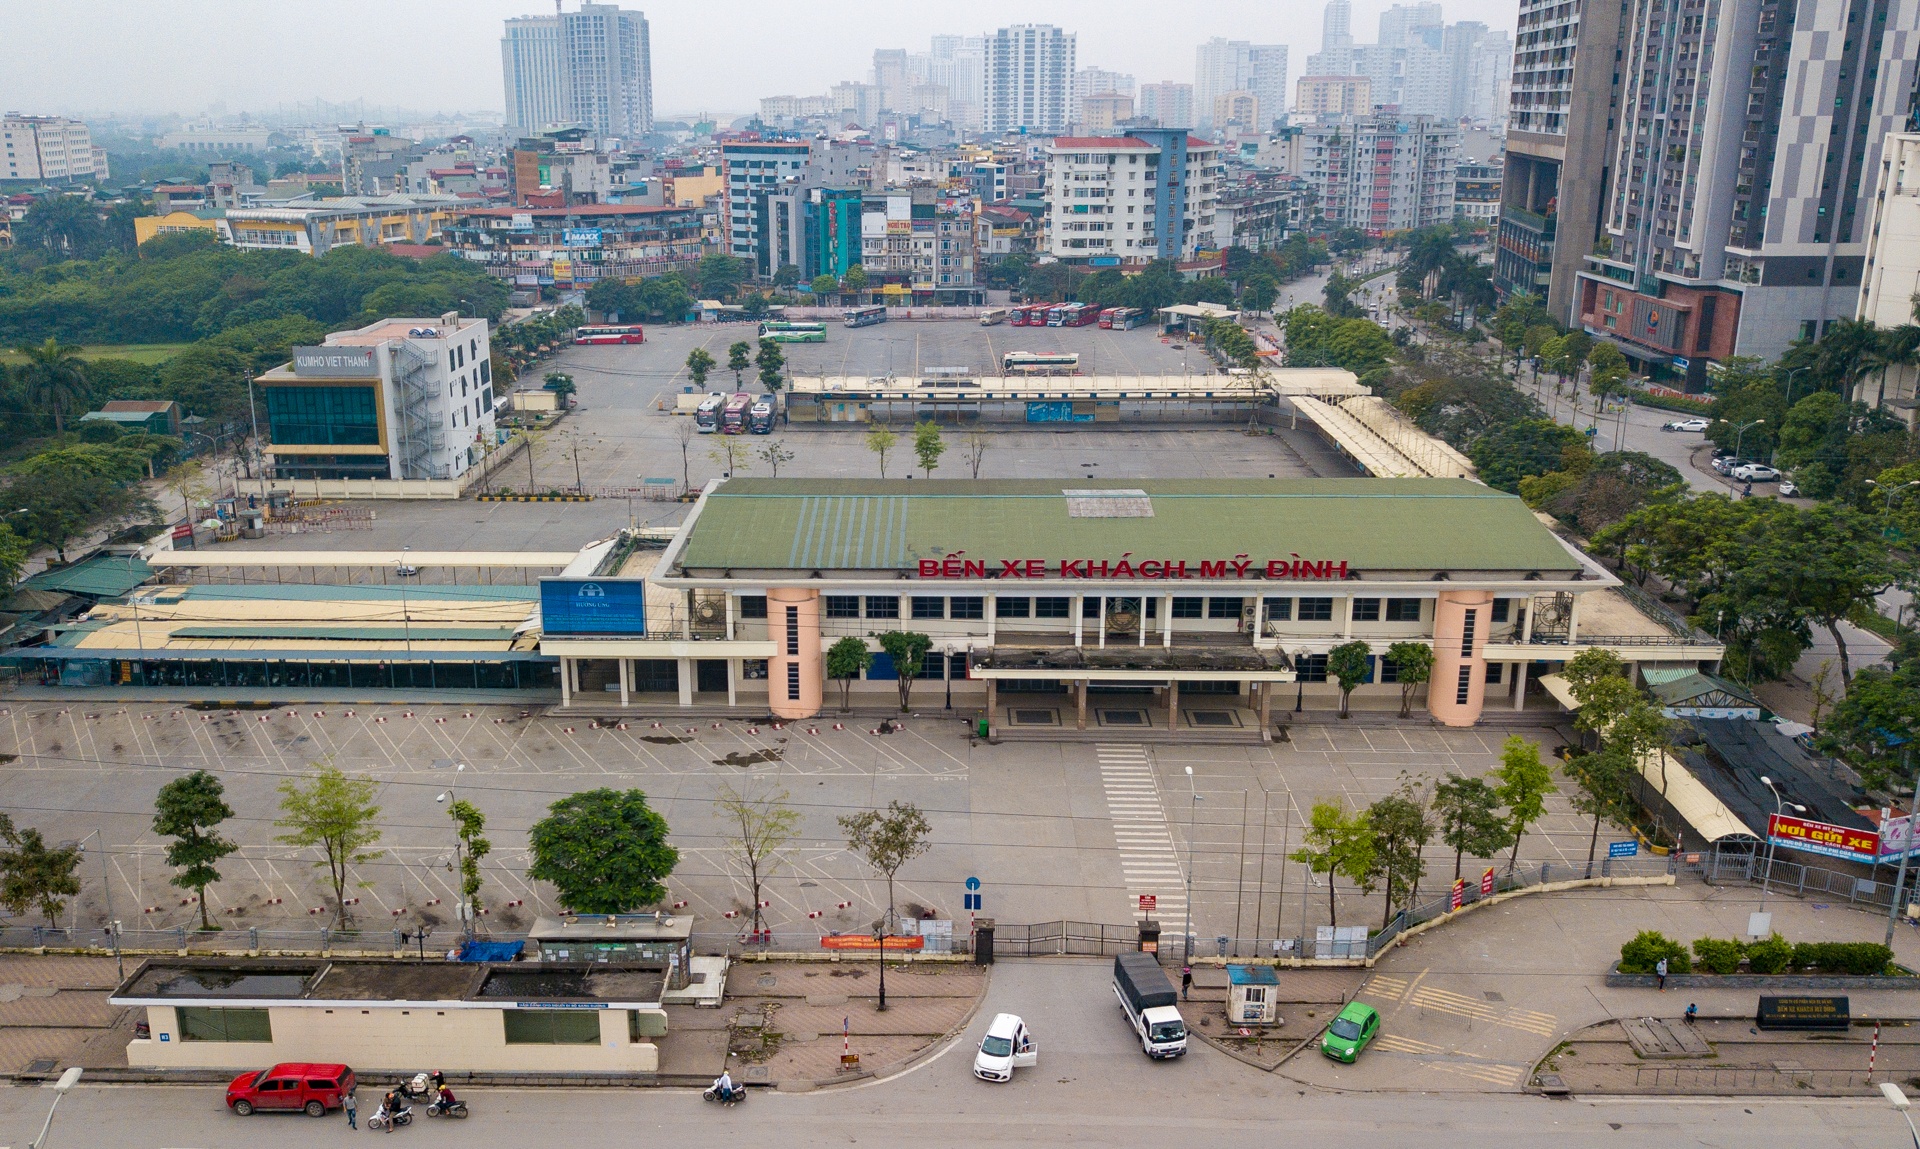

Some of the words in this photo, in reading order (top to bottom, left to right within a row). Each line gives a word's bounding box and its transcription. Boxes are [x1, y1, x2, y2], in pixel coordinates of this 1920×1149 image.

[297, 356, 325, 367] KUMHO
[325, 356, 342, 367] VIET
[343, 356, 369, 367] THANH
[918, 550, 985, 578] BẾN
[1000, 559, 1046, 578] XE
[1061, 552, 1186, 578] KHÁCH
[1200, 553, 1253, 578] MỸ
[1266, 552, 1348, 579] ĐÌNH
[1774, 823, 1806, 837] NƠI
[1811, 830, 1843, 844] GỬI
[1848, 836, 1873, 850] XE
